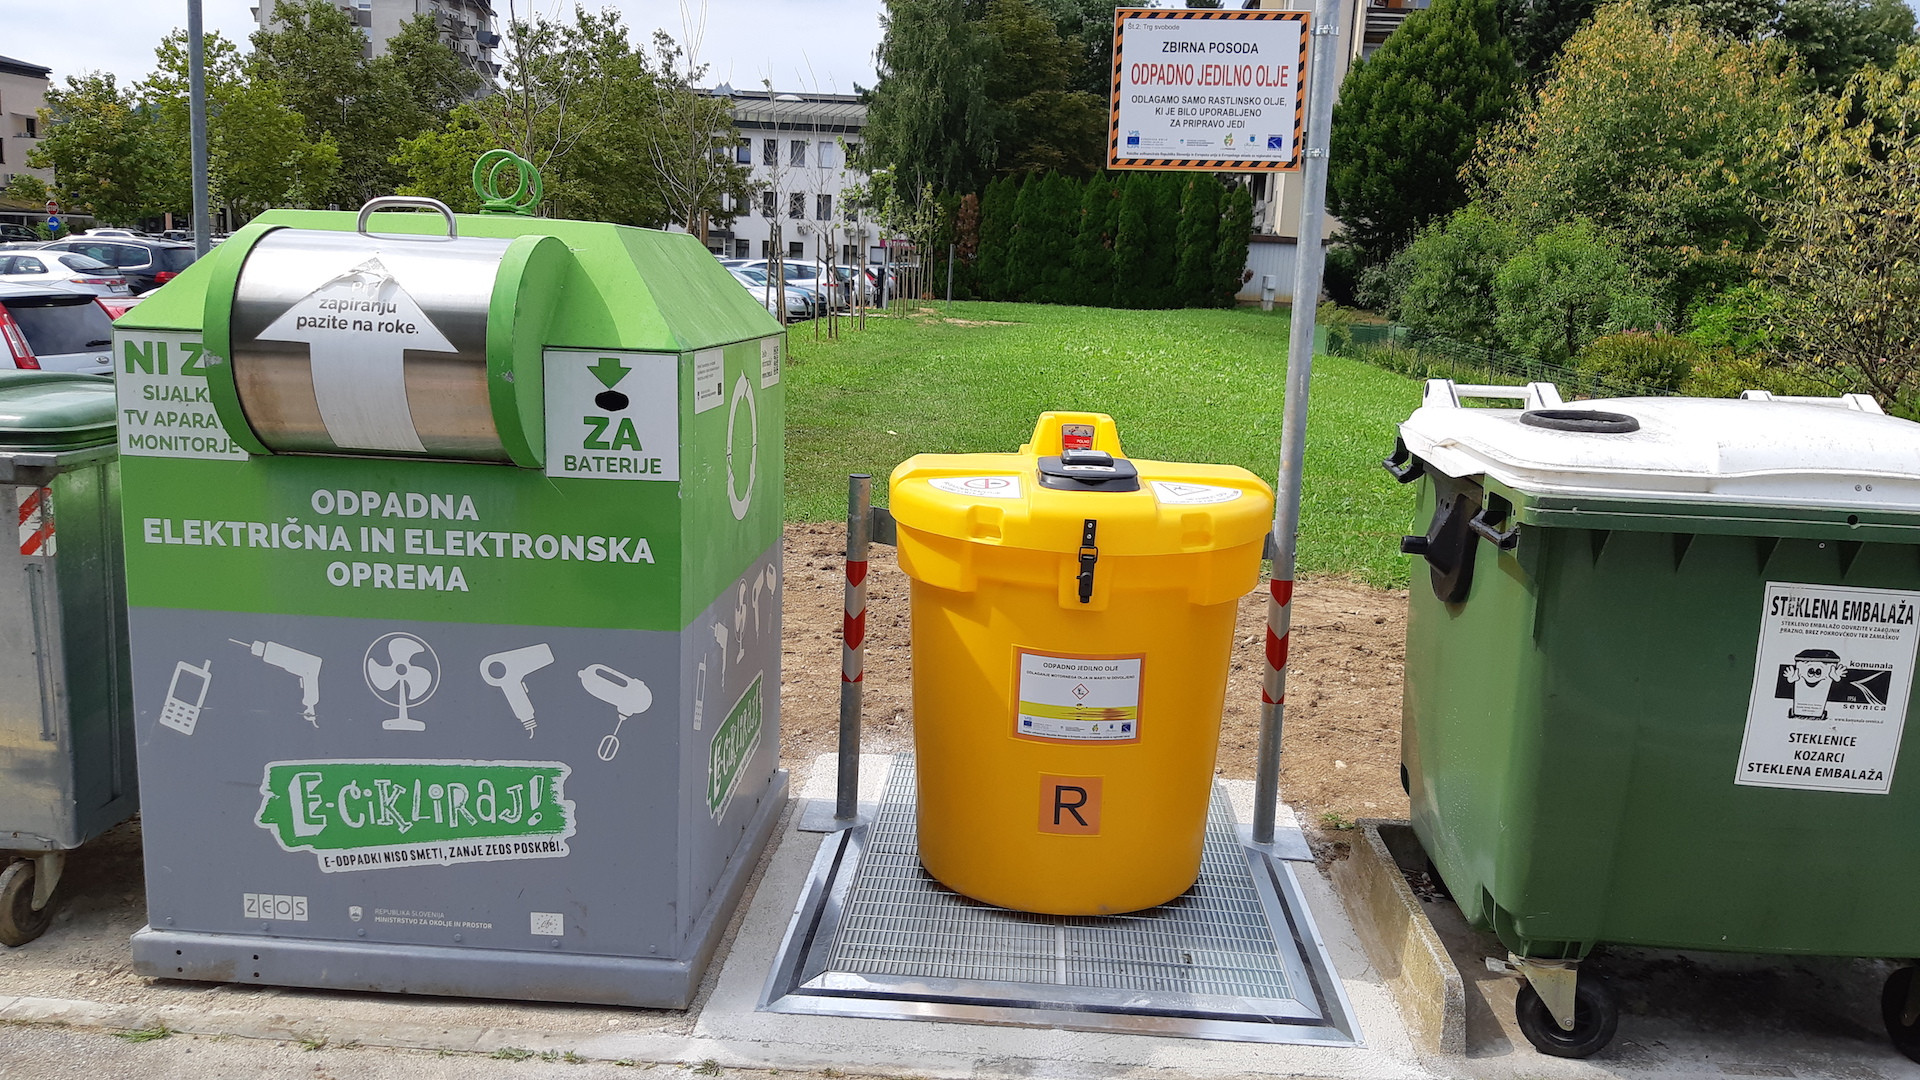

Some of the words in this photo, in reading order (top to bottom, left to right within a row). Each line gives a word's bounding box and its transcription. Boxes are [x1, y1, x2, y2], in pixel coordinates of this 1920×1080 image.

[1143, 24, 1153, 32] Trg
[1162, 41, 1206, 54] ZBIRNA
[1209, 42, 1259, 54] POSODA
[1131, 63, 1194, 86] ODPADNO
[1197, 64, 1252, 87] JEDILNO
[1255, 65, 1289, 87] OLJE
[1131, 95, 1179, 104] ODLAGAMO
[1181, 96, 1206, 105] SAMO
[1208, 96, 1261, 106] RASTLINSKO
[1263, 97, 1287, 107] OLJE,
[1155, 107, 1163, 116] KI
[1165, 107, 1175, 116] JE
[1177, 107, 1197, 116] BILO
[1199, 108, 1261, 117] UPORABLJENO
[1170, 119, 1181, 127] ZA
[1182, 119, 1225, 128] PRIPRAVO
[1226, 120, 1245, 128] JEDI
[318, 297, 397, 316] zapiranju
[296, 314, 349, 331] pazite
[352, 319, 373, 332] na
[378, 319, 419, 334] roke.
[124, 340, 169, 375] NI
[180, 342, 207, 377] Z
[124, 409, 148, 426] TV
[153, 410, 218, 429] APARA
[583, 415, 643, 451] ZA
[128, 433, 240, 454] MONITORJE
[564, 454, 662, 474] BATERIJE
[310, 488, 479, 521] ODPADNA
[143, 517, 353, 552] ELEKTRIČNA
[360, 527, 396, 554] IN
[405, 528, 656, 565] ELEKTRONSKA
[326, 561, 469, 592] OPREMA
[1770, 595, 1839, 620] STEKLENA
[1841, 599, 1914, 626] EMBALAŽA
[1781, 620, 1810, 628] STEKLENO
[1810, 621, 1840, 630] EMBALAŽO
[1841, 624, 1868, 632] ODVRZITE
[1820, 630, 1858, 638] POKROVČKOV
[1869, 633, 1900, 641] ZAMAŠKOV
[1043, 662, 1076, 671] ODPADNO
[1849, 660, 1893, 669] komunala
[1842, 703, 1887, 711] sevnica
[1788, 732, 1857, 747] STEKLENICE
[1794, 750, 1845, 763] KOZARCI
[1747, 763, 1811, 777] STEKLENA
[1814, 766, 1883, 781] EMBALAŽA
[1053, 785, 1088, 826] R
[324, 852, 382, 868] E-ODPADKI
[383, 849, 408, 864] NISO
[410, 847, 448, 862] SMETI,
[449, 844, 484, 859] ZANJE
[485, 843, 512, 856] ZEOS
[514, 840, 564, 855] POSKRBI.
[246, 897, 306, 917] ZEOS
[375, 908, 411, 917] REPUBLIKA
[411, 909, 445, 919] SLOVENIJA
[375, 916, 418, 925] MINISTRSTVO
[429, 919, 453, 927] OKOLJE
[462, 921, 493, 929] PROSTOR
